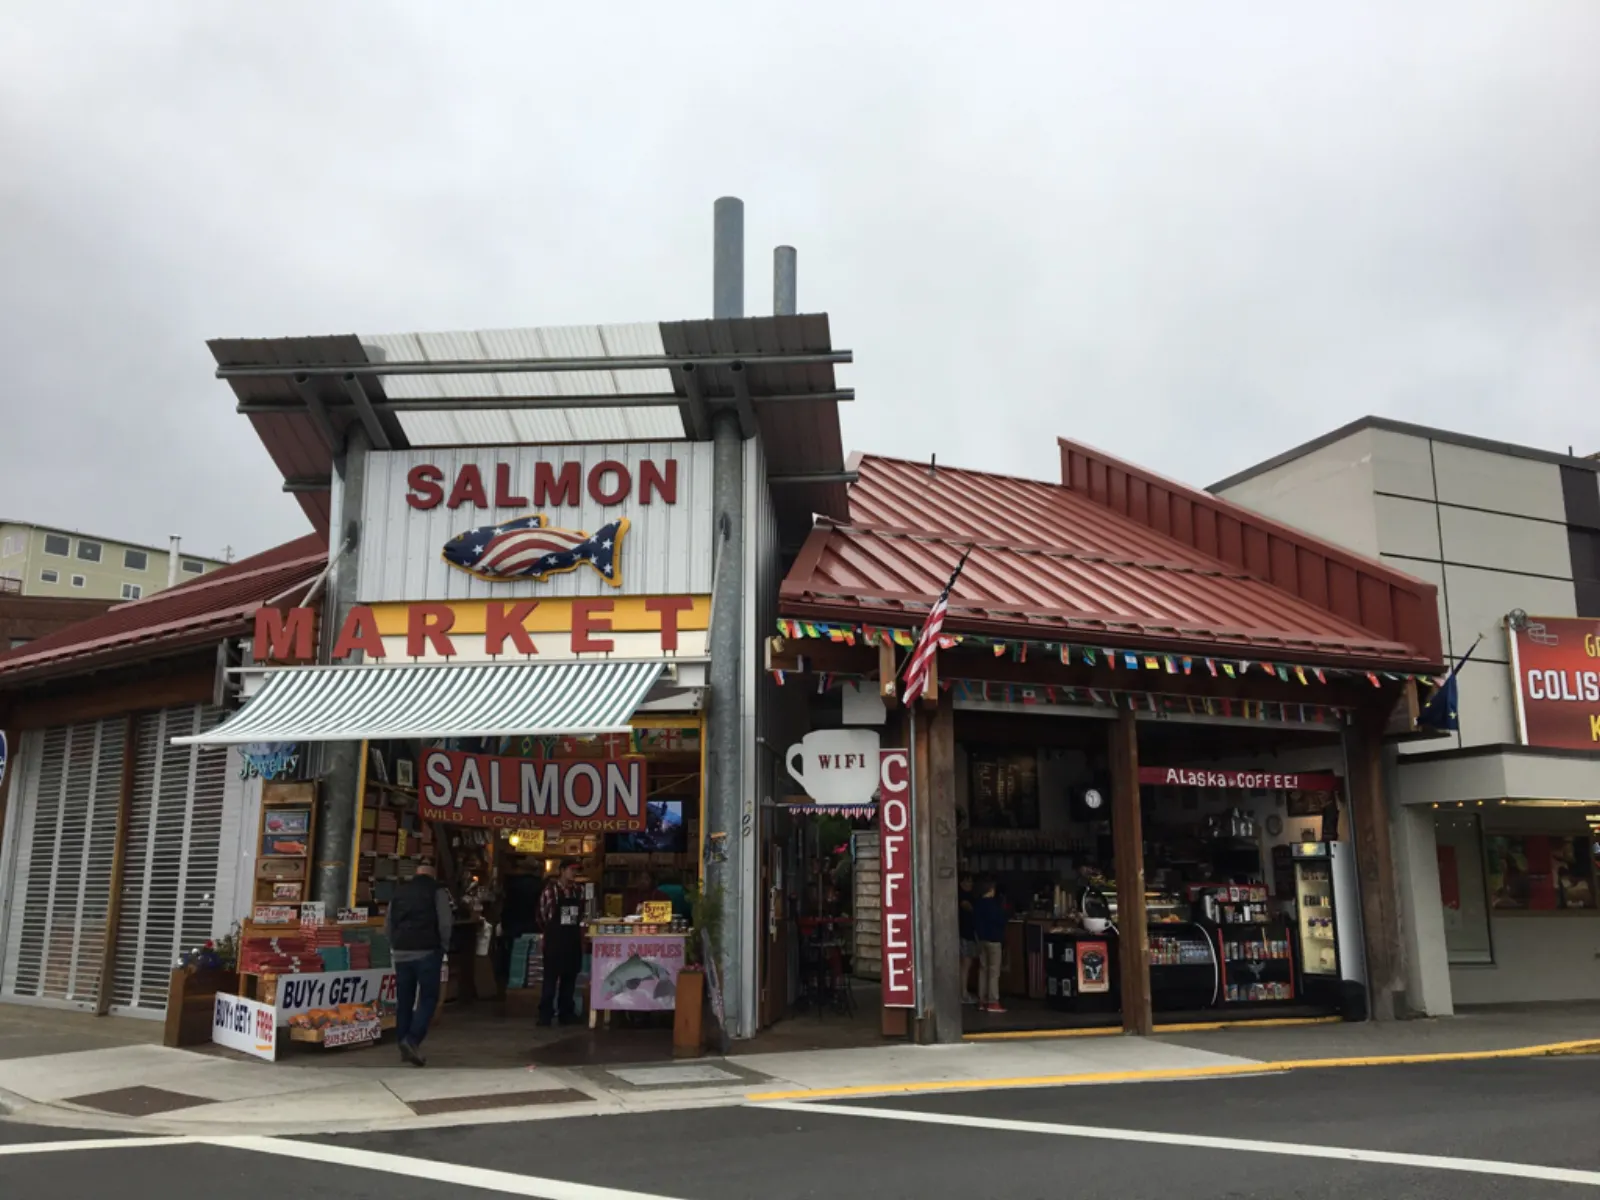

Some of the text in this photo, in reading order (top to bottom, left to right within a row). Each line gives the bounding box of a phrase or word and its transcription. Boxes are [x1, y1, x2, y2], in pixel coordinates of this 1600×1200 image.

[405, 458, 677, 510] SALMON
[253, 596, 694, 660] MARKET
[1527, 669, 1600, 701] COLIS
[239, 753, 300, 778] Jewelry
[817, 753, 866, 770] WIFI
[423, 751, 641, 818] SALMON
[1236, 772, 1299, 789] COFFEE!
[423, 807, 641, 832] WILD LOCAL SMOKED
[880, 754, 910, 992] COFFEE
[594, 941, 683, 959] FREE SAMPLES
[379, 974, 397, 1001] FR
